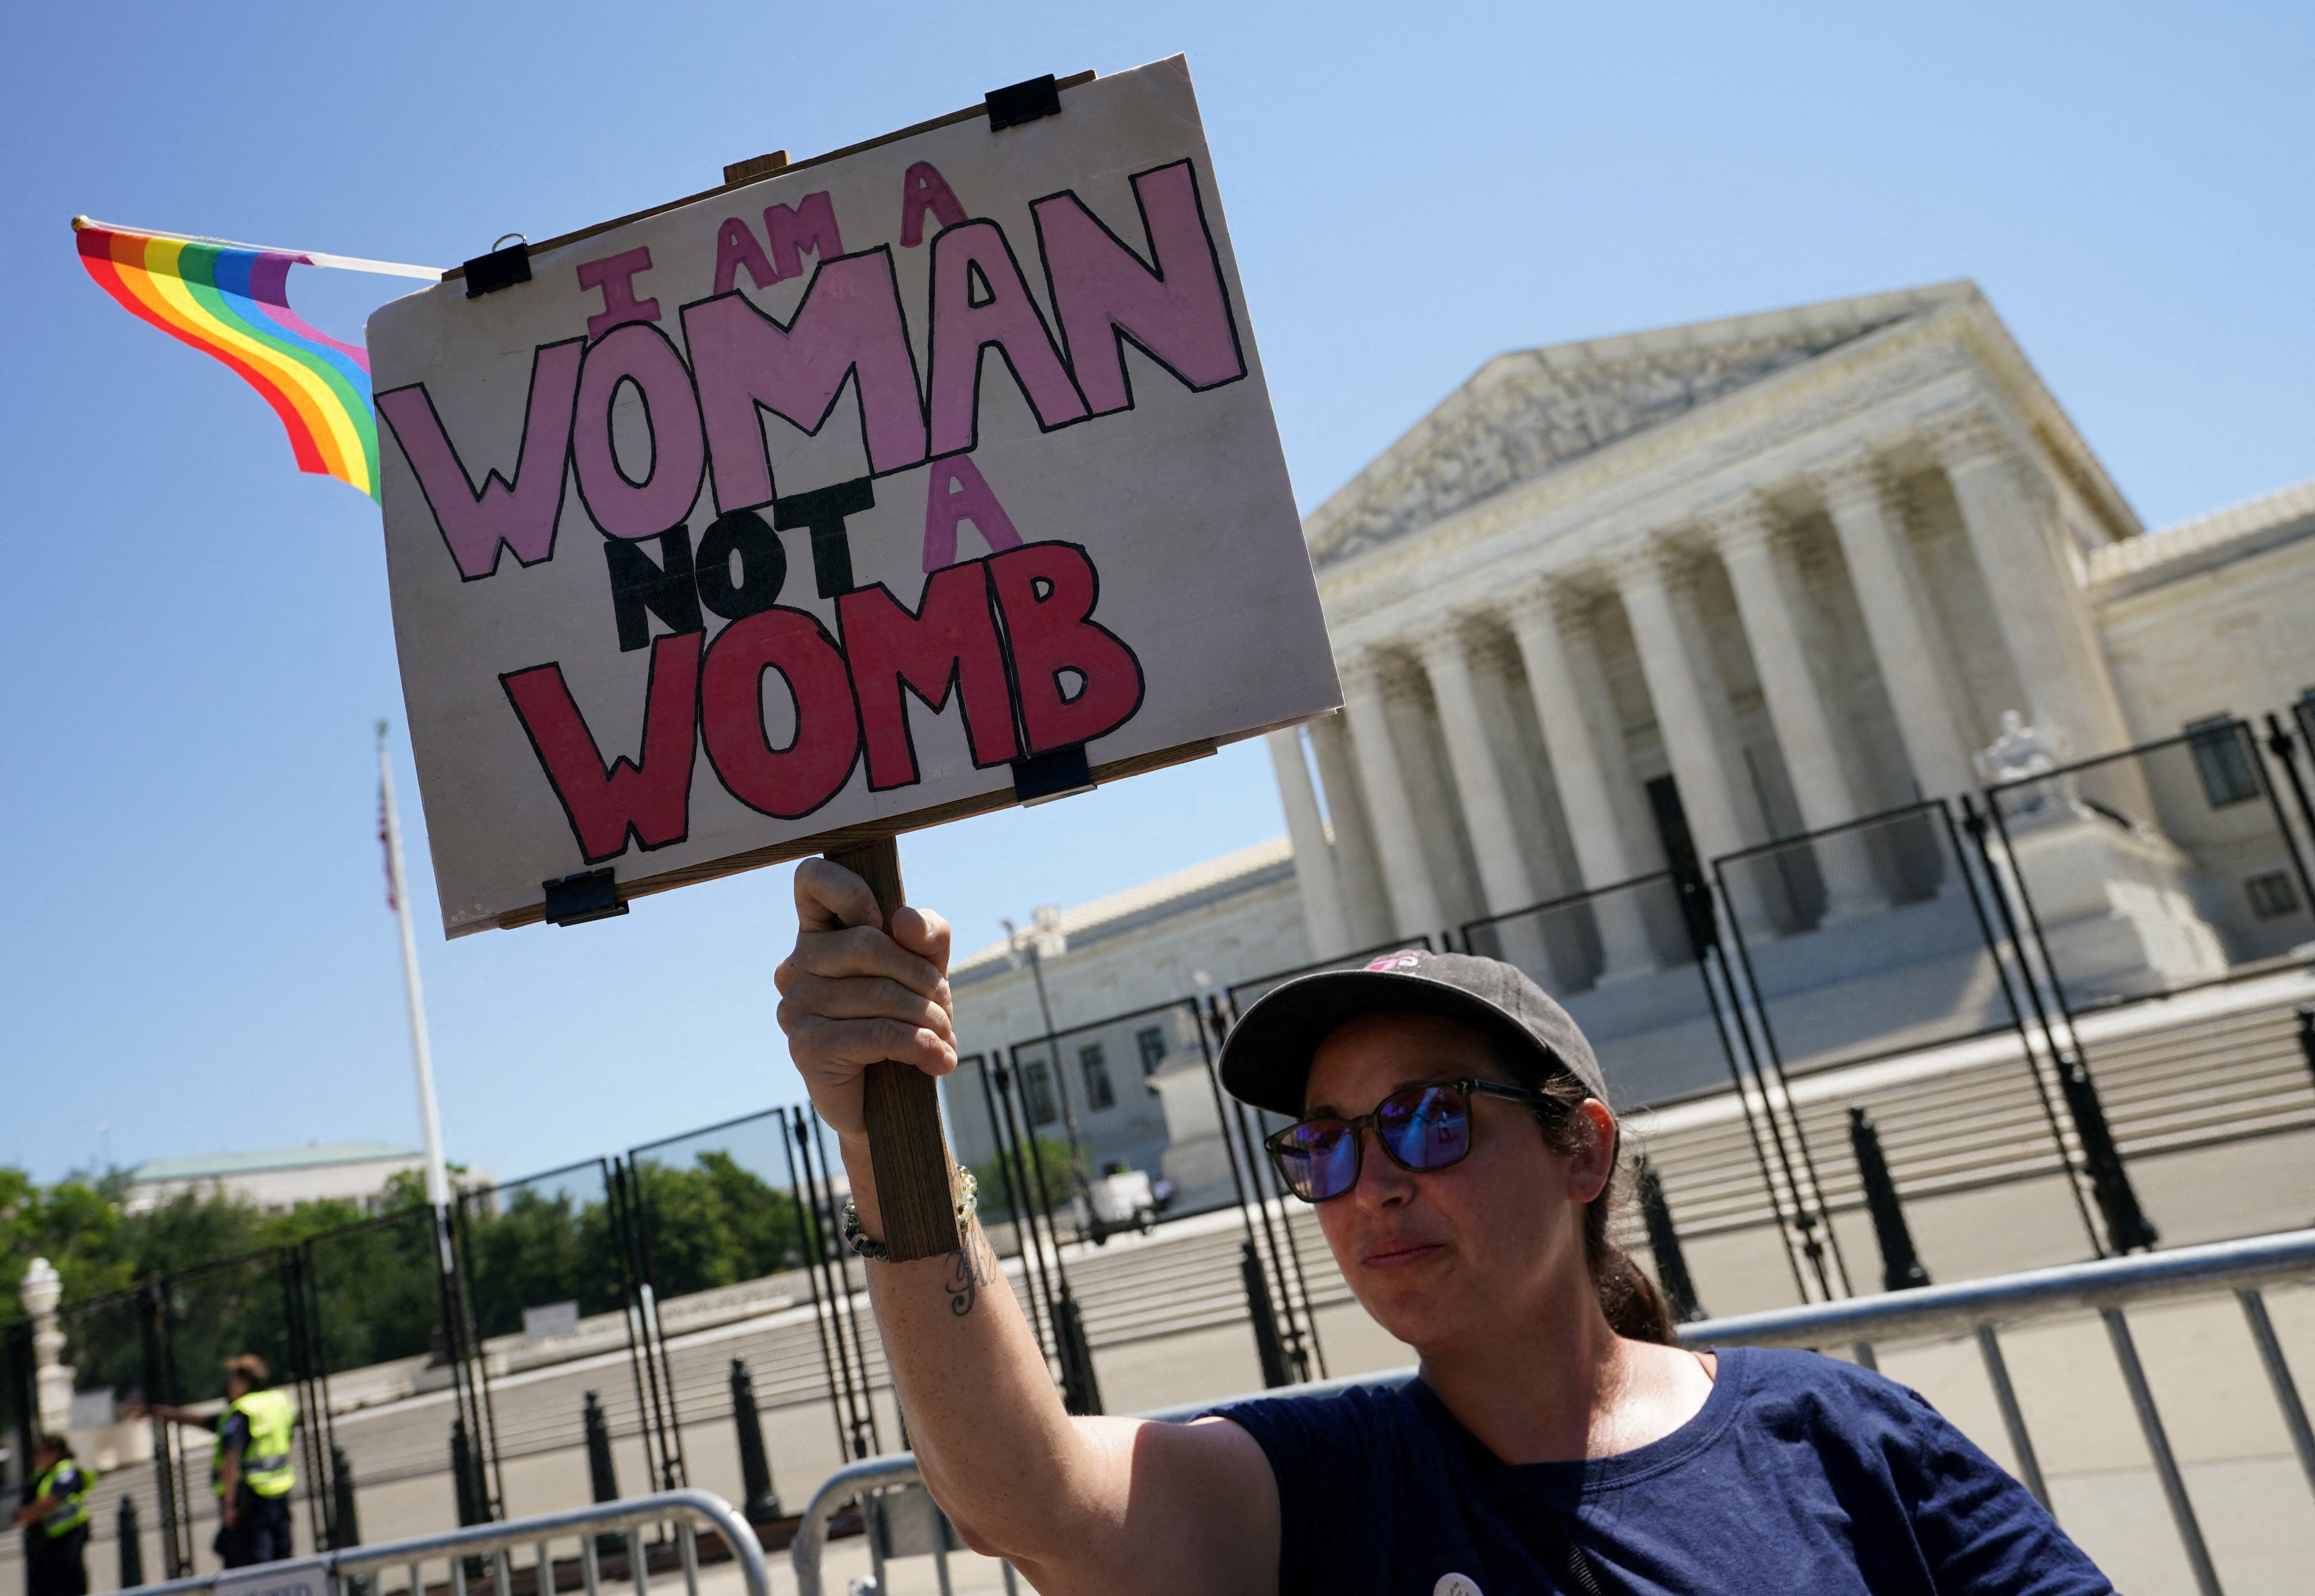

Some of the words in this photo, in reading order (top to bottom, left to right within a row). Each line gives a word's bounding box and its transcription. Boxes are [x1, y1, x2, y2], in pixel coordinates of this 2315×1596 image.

[374, 159, 1246, 581] WOMAN
[577, 225, 661, 339] I
[714, 191, 844, 297] AM
[900, 160, 970, 247] A
[604, 476, 875, 652] NOT
[922, 453, 1023, 573] A
[500, 540, 1143, 865] WOMB
